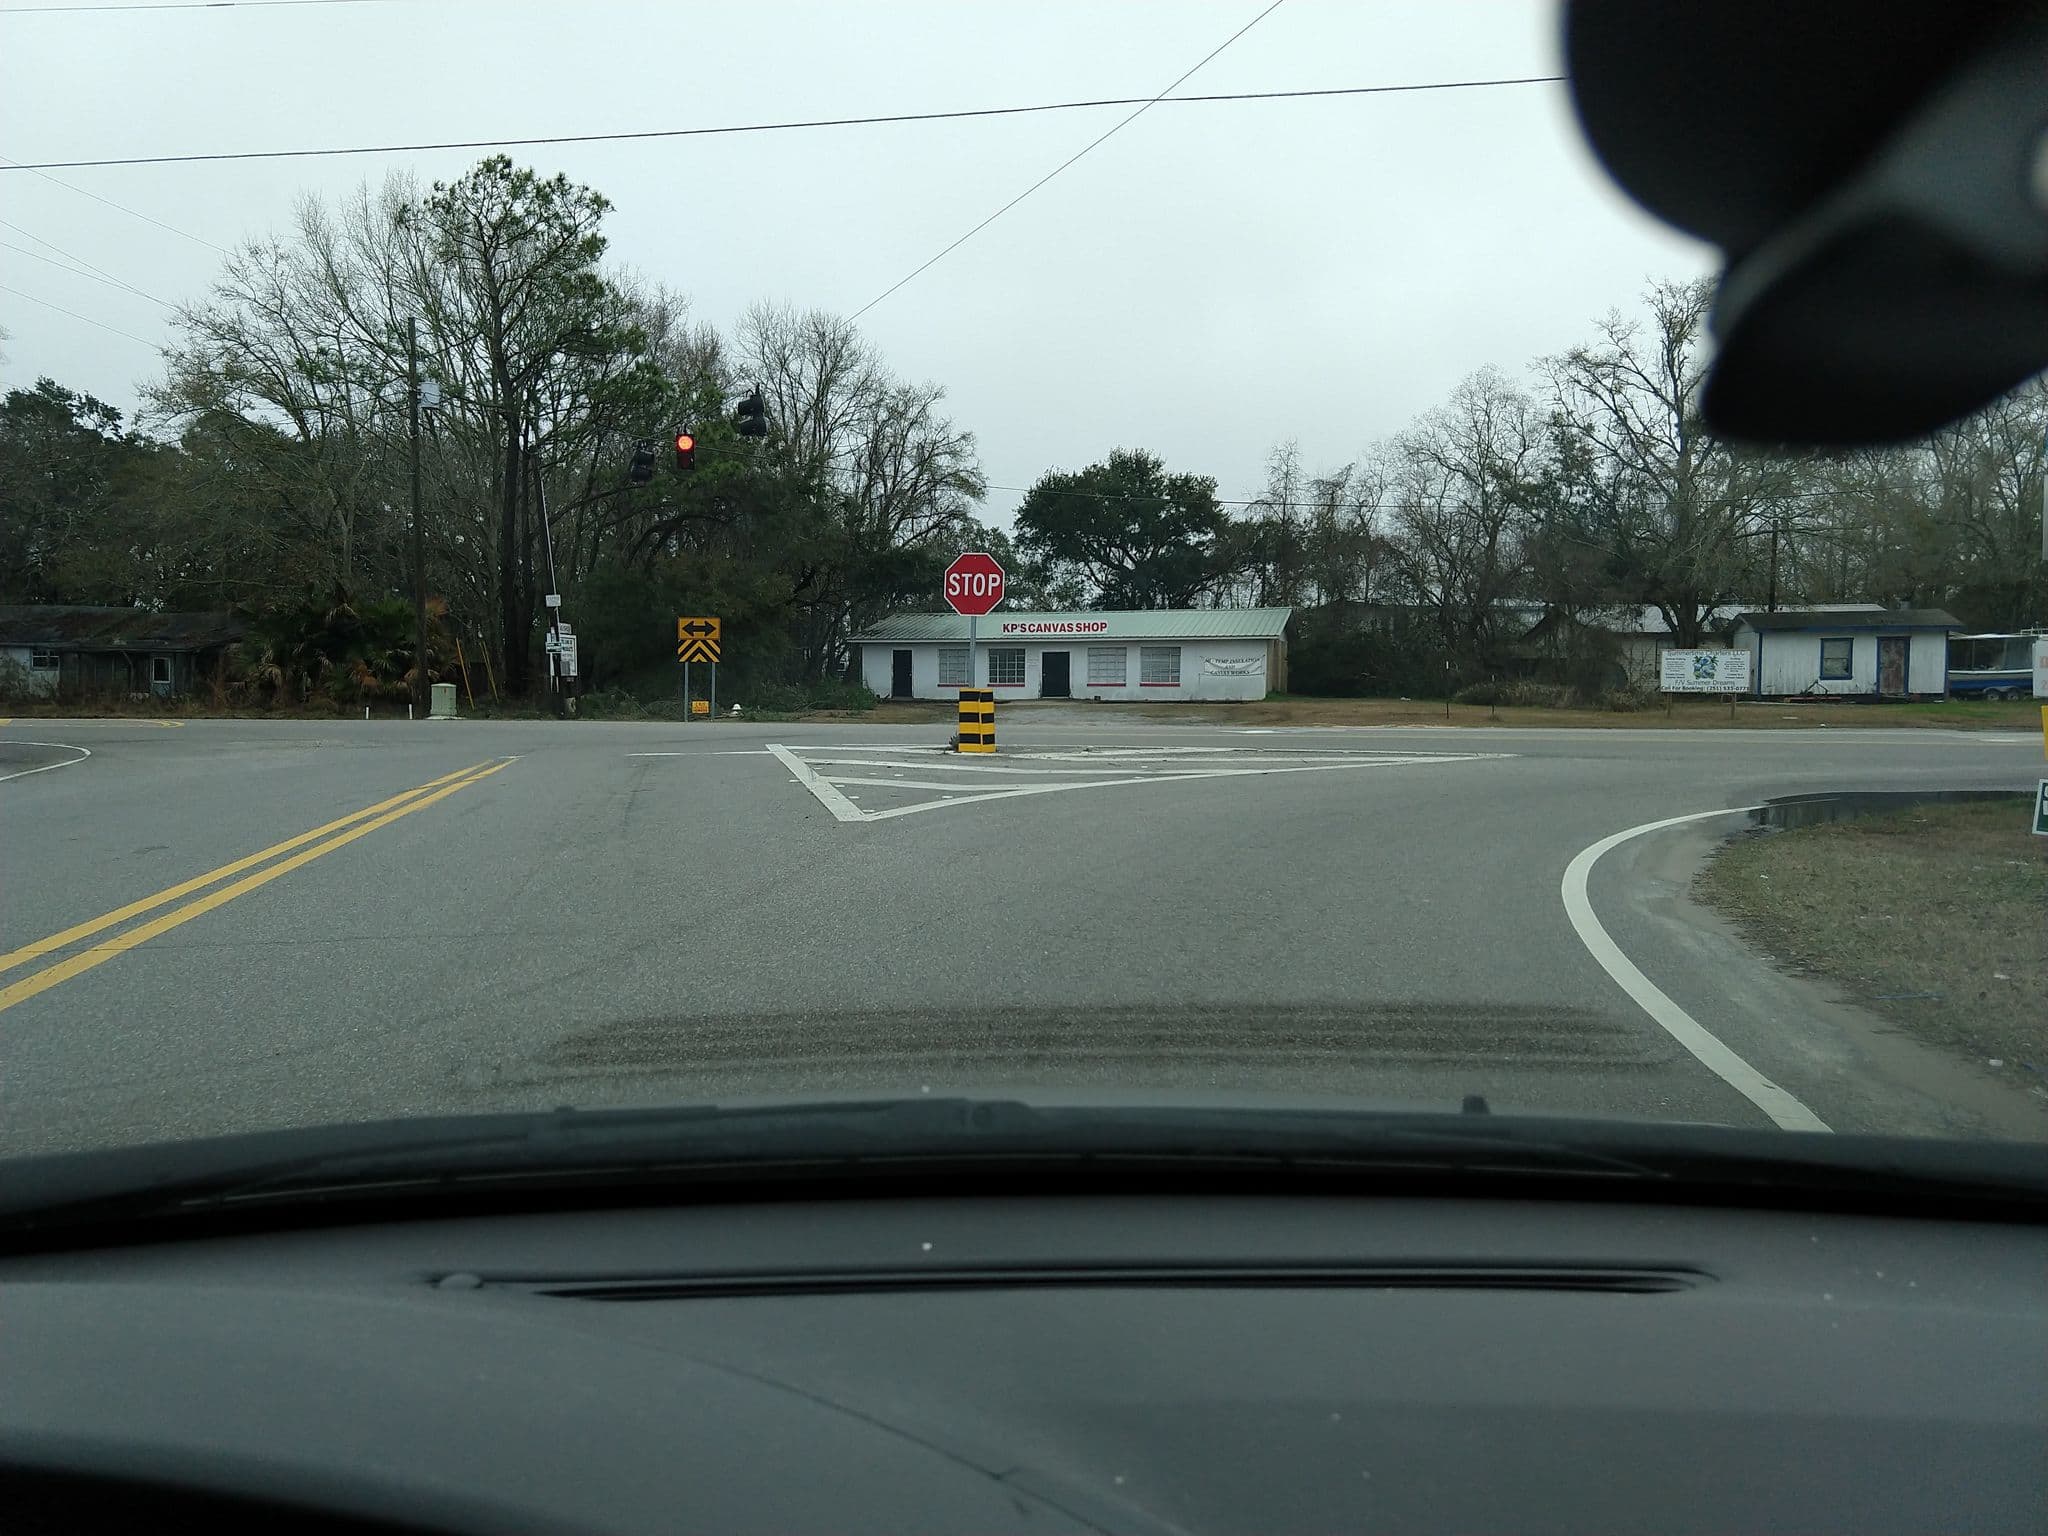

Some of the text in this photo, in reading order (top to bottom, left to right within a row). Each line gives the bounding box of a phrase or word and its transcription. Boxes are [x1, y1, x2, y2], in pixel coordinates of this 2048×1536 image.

[948, 573, 1001, 597] STOP
[1002, 622, 1108, 633] KP'S CANVAS SHOP
